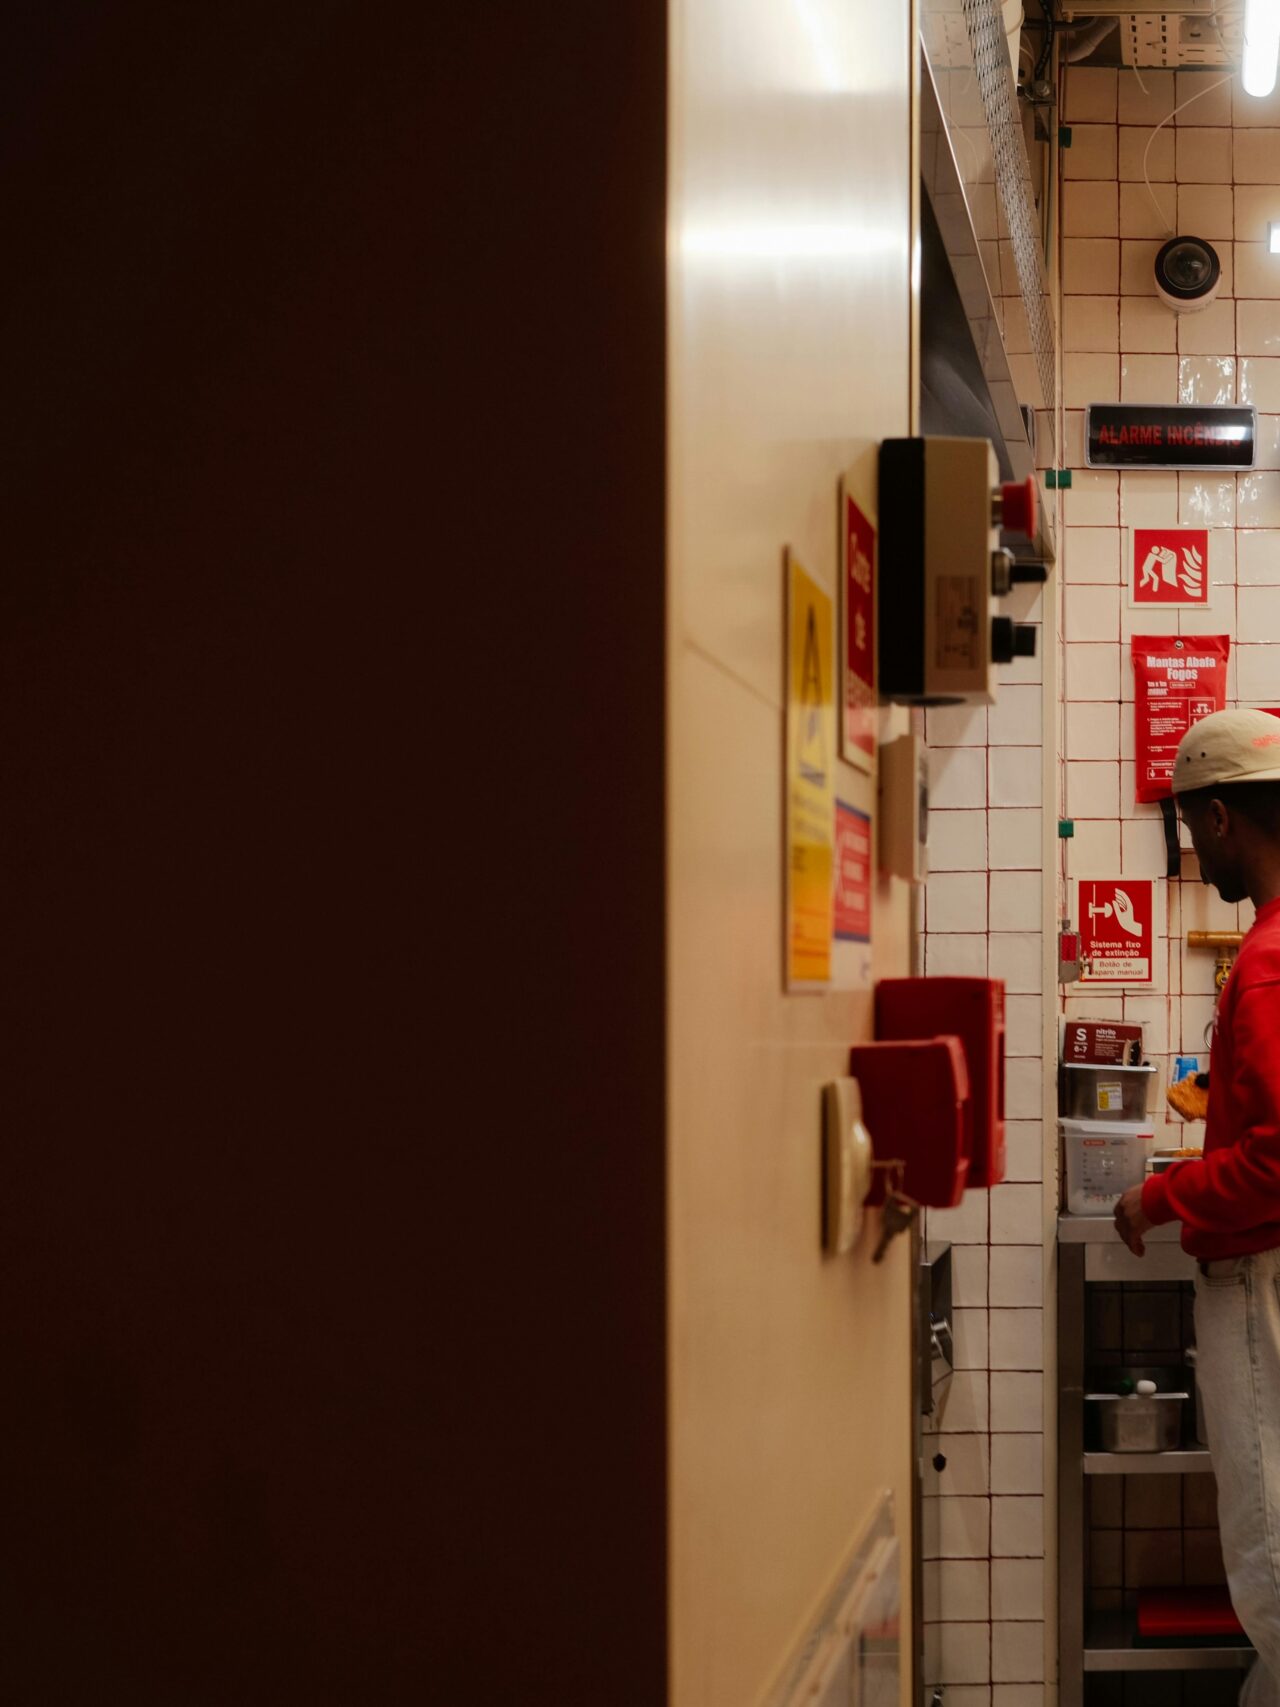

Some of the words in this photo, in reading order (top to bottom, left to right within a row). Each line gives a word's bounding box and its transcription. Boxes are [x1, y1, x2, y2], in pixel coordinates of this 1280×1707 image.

[1099, 424, 1162, 445] ALARME
[1147, 656, 1185, 668] Mantas
[1186, 656, 1216, 668] Abafa
[1167, 667, 1198, 681] Fogos
[1090, 940, 1123, 949] Sistema
[1125, 940, 1142, 949] fixo
[1091, 949, 1102, 957] de
[1105, 949, 1140, 958] extinção
[1076, 1028, 1087, 1041] S
